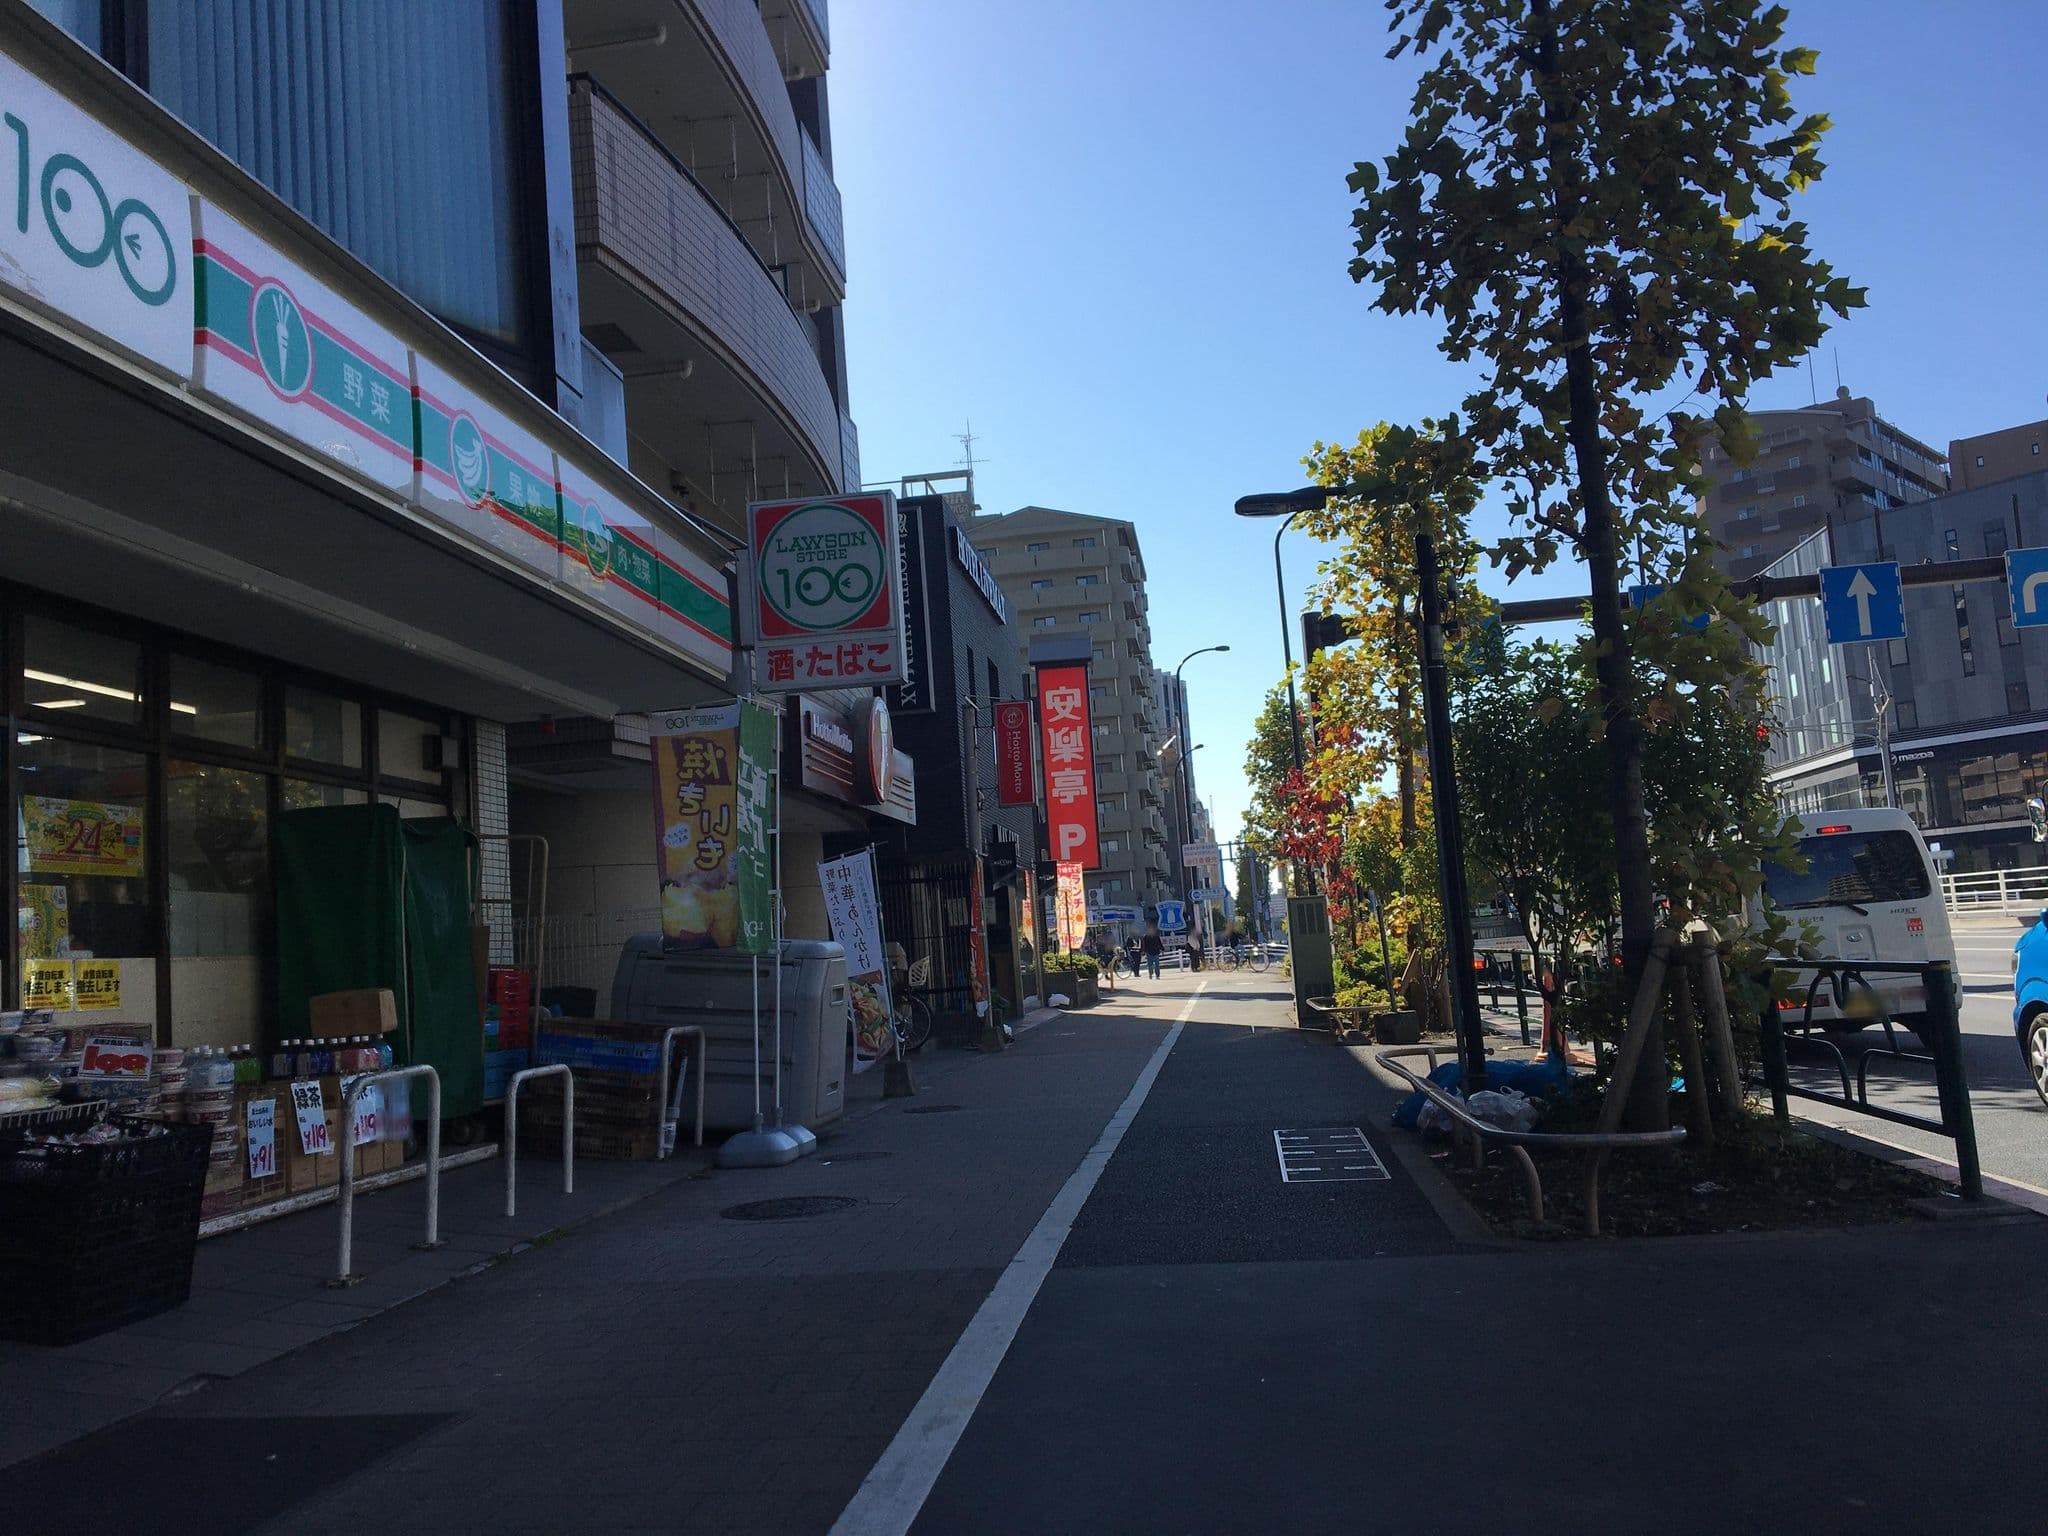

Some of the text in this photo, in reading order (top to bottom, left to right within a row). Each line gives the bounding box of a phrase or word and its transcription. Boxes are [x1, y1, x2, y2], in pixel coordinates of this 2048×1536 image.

[343, 362, 391, 425] 野菜
[775, 530, 867, 554] LAWSON
[796, 548, 848, 563] STORE
[776, 563, 874, 610] 100
[767, 643, 891, 682] 酒・たばこ
[1045, 686, 1089, 804] 安楽亭
[1058, 823, 1086, 861] P
[838, 864, 871, 970] 中華あんかけ
[303, 1123, 327, 1151] ¥119
[251, 1143, 273, 1175] ¥91
